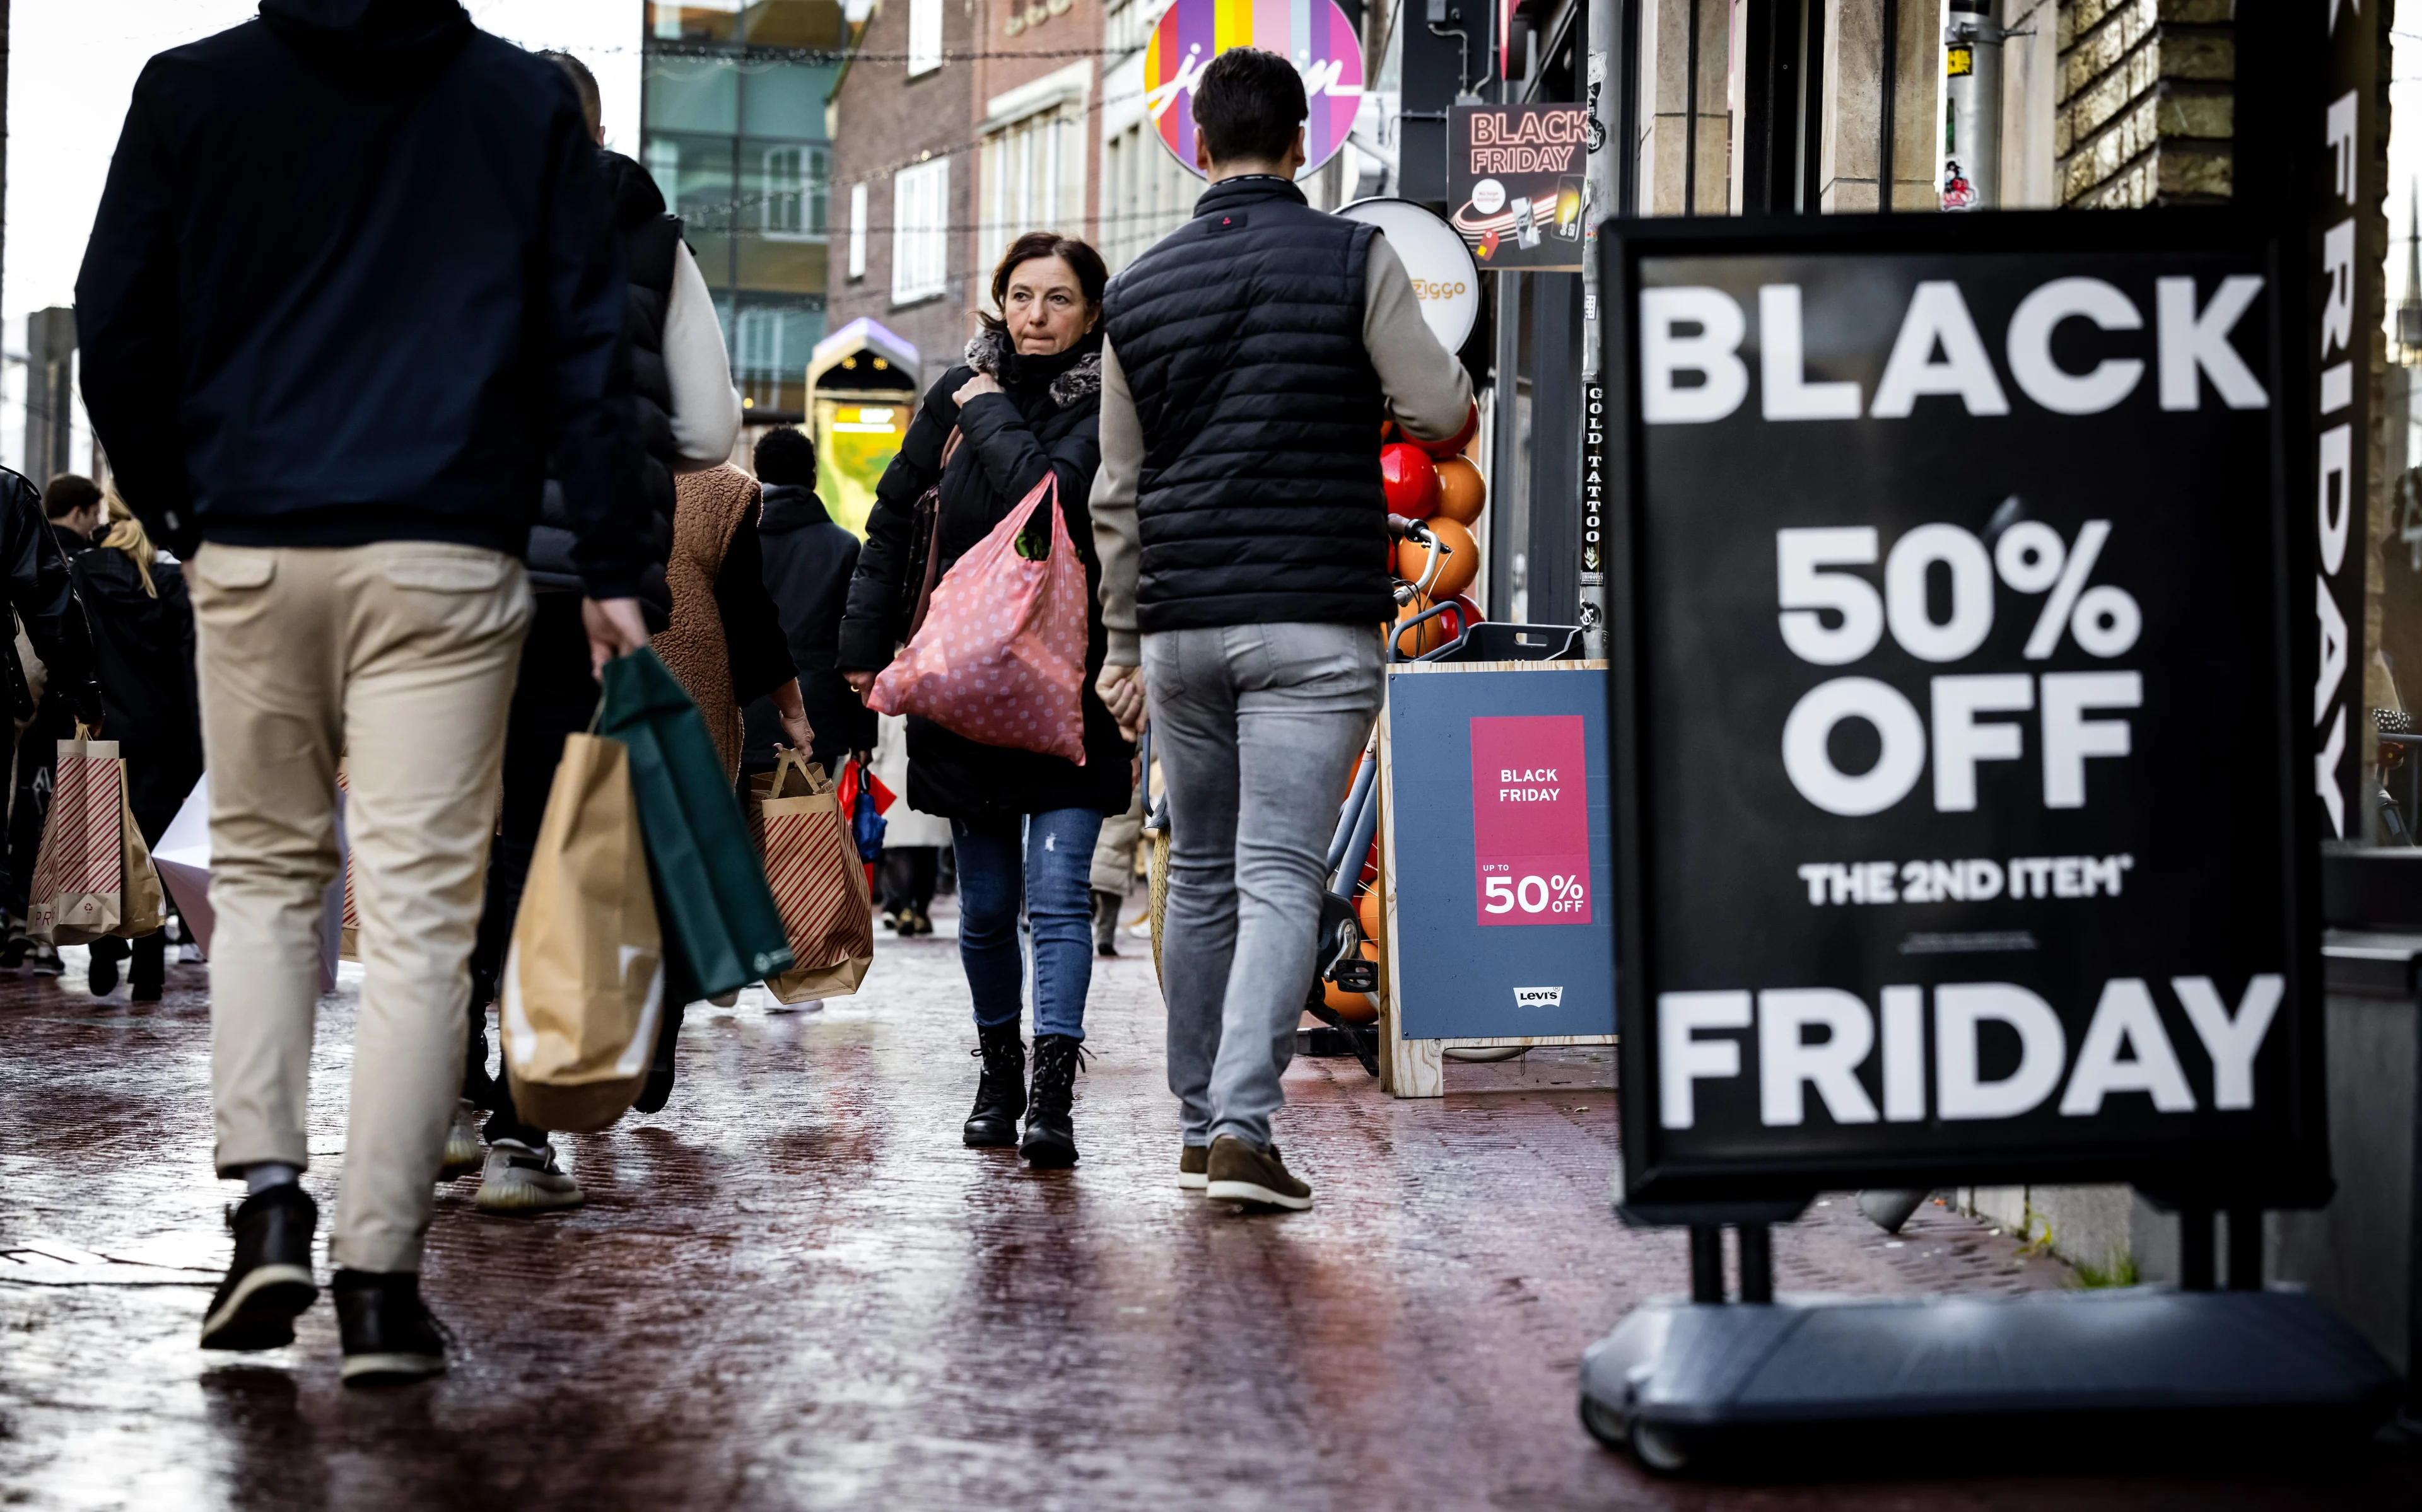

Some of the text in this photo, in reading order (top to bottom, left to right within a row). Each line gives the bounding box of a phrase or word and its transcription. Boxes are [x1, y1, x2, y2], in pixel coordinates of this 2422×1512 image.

[1471, 111, 1588, 146] BLACK
[1471, 145, 1574, 174] FRIDAY
[1641, 275, 2269, 424] BLACK
[1586, 388, 1603, 542] GOLD TATTOO
[2314, 90, 2358, 841] FRIDAY
[1776, 519, 2141, 665] 50%
[1782, 671, 2142, 816] OFF
[1499, 788, 1560, 802] FRIDAY
[1501, 769, 1558, 782] BLACK
[1485, 874, 1584, 914] 50%
[1798, 861, 1898, 906] THE
[1901, 859, 2004, 903] 2ND
[1552, 900, 1584, 913] OFF
[1658, 974, 2286, 1130] FRIDAY
